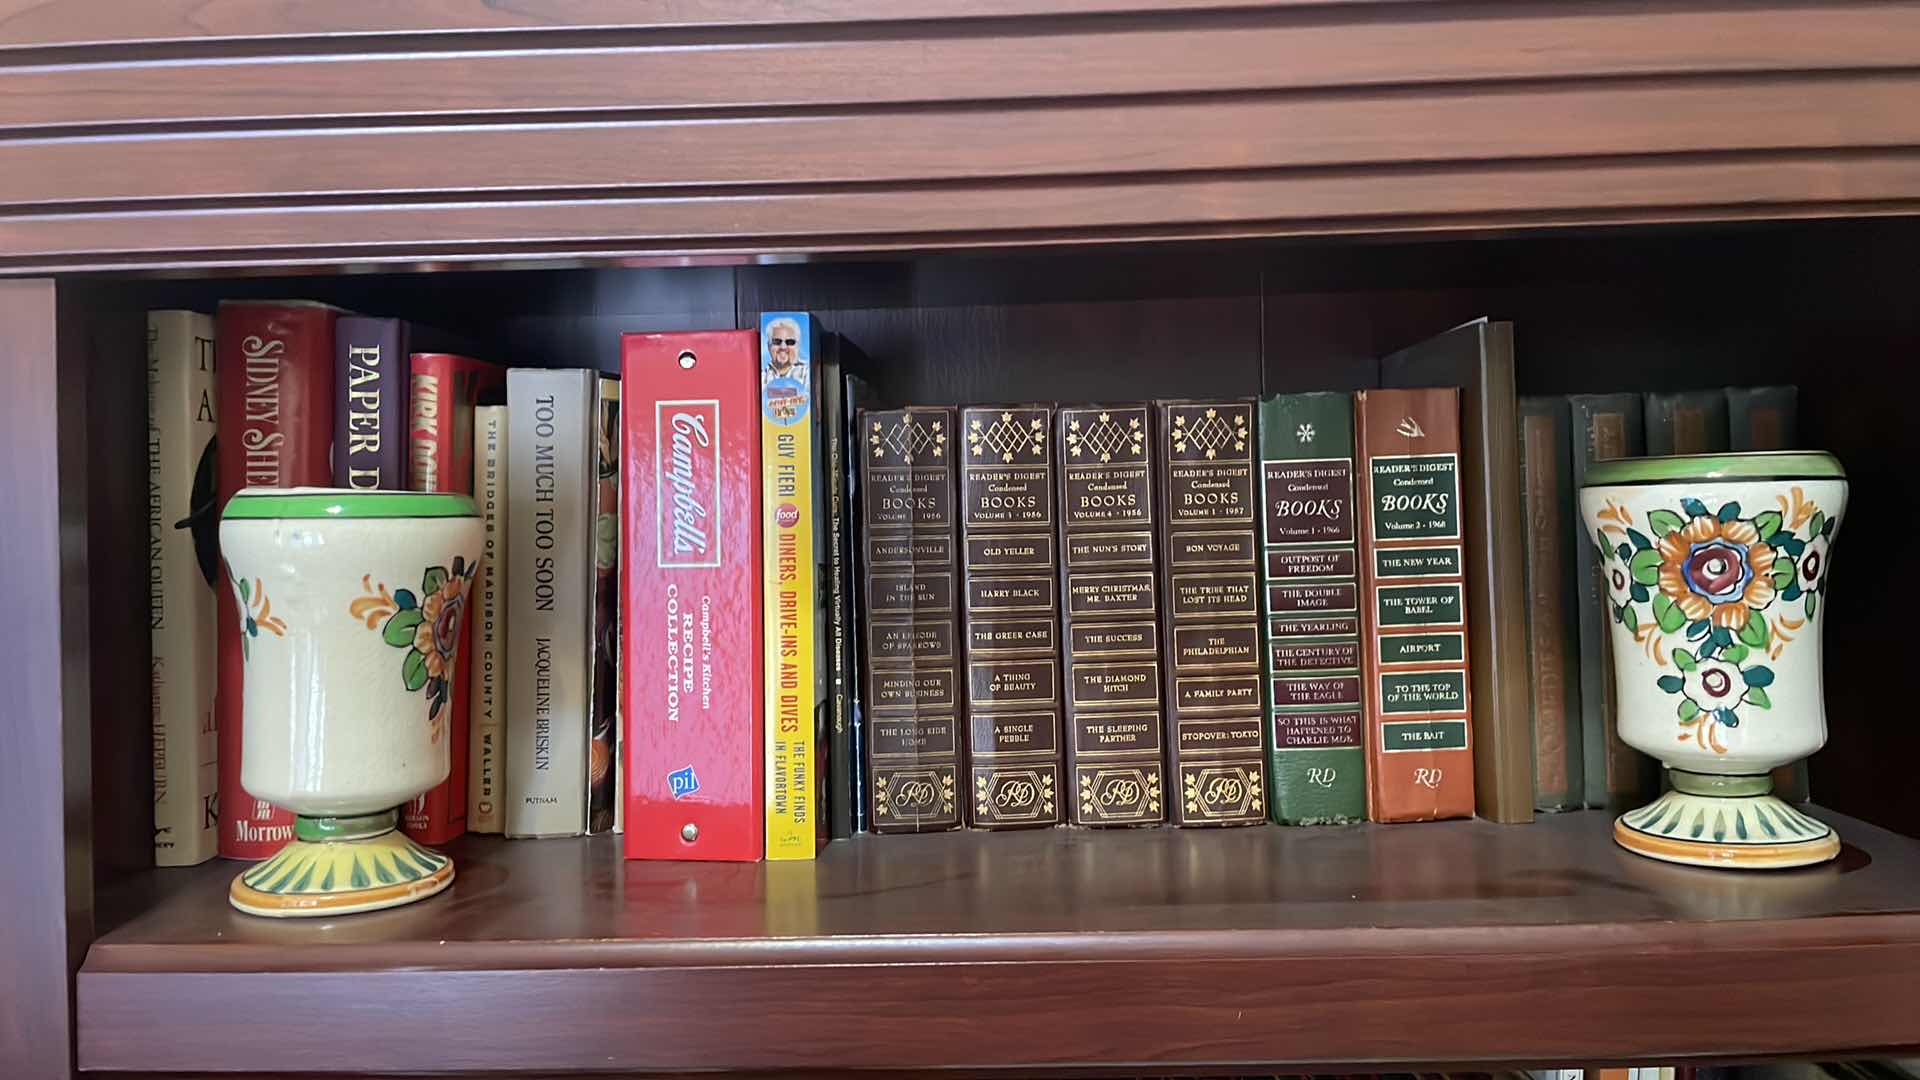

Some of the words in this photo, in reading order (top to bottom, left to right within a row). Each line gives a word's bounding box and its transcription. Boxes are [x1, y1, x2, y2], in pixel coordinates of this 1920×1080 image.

[242, 335, 285, 424] SIDNEY
[348, 343, 381, 457] PAPER
[415, 374, 438, 436] KIRK
[535, 395, 554, 437] TOO
[487, 419, 496, 451] THE
[777, 434, 794, 458] GUY
[1217, 468, 1248, 477] DIGEST
[1420, 463, 1454, 472] DIGEST
[535, 444, 554, 502] MUCH
[1014, 472, 1046, 480] DIGEST
[1114, 470, 1145, 479] DIGEST
[1268, 470, 1312, 479] READER'S
[1314, 469, 1346, 478] DIGEST
[778, 464, 796, 497] FIERI
[1191, 479, 1230, 489] Condensed
[486, 458, 496, 532] BRIDGES
[1184, 492, 1239, 505] BOOKS
[882, 498, 936, 509] BOOKS
[981, 496, 1036, 508] BOOKS
[1081, 494, 1136, 508] BOOKS
[1382, 493, 1449, 515] BOOKS
[776, 508, 798, 522] food
[1178, 508, 1209, 516] VOLUME
[1275, 500, 1343, 520] BOOKS
[149, 479, 163, 558] AFRICAN
[535, 508, 554, 550] TOO
[1280, 526, 1309, 535] Volume
[1384, 522, 1415, 531] Volume
[1416, 521, 1421, 529] 2
[832, 532, 840, 556] Secret
[1121, 544, 1147, 552] STORY
[1186, 545, 1203, 553] BON
[1206, 544, 1240, 552] VOYAGE
[485, 540, 494, 560] OF
[984, 548, 1001, 556] OLD
[1004, 548, 1034, 556] YELLER
[776, 533, 797, 585] DINERS,
[833, 557, 840, 565] to
[1281, 556, 1325, 564] OUTPOST
[1328, 554, 1340, 563] OF
[1382, 559, 1402, 568] THE
[1402, 558, 1424, 567] NEW
[1426, 557, 1452, 566] YEAR
[1288, 564, 1334, 574] FREEDOM
[535, 556, 554, 611] SOON
[833, 566, 841, 594] Healing
[981, 590, 1009, 598] HARRY
[1013, 589, 1040, 597] BLACK
[1072, 586, 1099, 594] MERRY
[1180, 587, 1197, 595] THE
[1200, 586, 1224, 594] TRIBE
[1226, 585, 1249, 593] THAT
[1282, 590, 1302, 599] THE
[1304, 588, 1341, 598] DOUBLE
[1104, 594, 1137, 602] BAXTER
[1184, 596, 1205, 604] LOST
[1224, 594, 1247, 603] HEAD
[1297, 598, 1329, 607] IMAGE
[1383, 598, 1403, 607] THE
[1404, 597, 1438, 606] TOWER
[1440, 596, 1454, 605] OF
[484, 567, 494, 642] MADISON
[833, 595, 841, 625] Virtually
[1404, 606, 1433, 615] BABEL
[700, 595, 711, 661] Campbell's
[780, 591, 798, 657] DRIVE-INS
[1280, 624, 1299, 633] THE
[1301, 623, 1349, 632] YEARLING
[975, 632, 993, 640] THE
[995, 632, 1023, 640] GREER
[1026, 630, 1048, 639] CASE
[1106, 634, 1143, 643] SUCCESS
[1208, 638, 1225, 646] THE
[667, 583, 679, 722] COLLECTION
[682, 612, 694, 693] RECIPE
[1184, 647, 1250, 656] PHILADELPHIAN
[1276, 649, 1294, 657] THE
[1294, 648, 1340, 657] CENTURY
[1399, 644, 1441, 654] AIRPORT
[1278, 658, 1297, 666] THE
[1300, 657, 1354, 666] DETECTIVE
[535, 637, 551, 715] JACQUELINE
[780, 663, 798, 688] AND
[994, 674, 1001, 682] A
[1003, 674, 1030, 682] THING
[1084, 676, 1102, 684] THE
[1106, 674, 1146, 683] DIAMOND
[483, 651, 493, 718] COUNTY
[702, 664, 712, 709] Kitchen
[990, 684, 1002, 692] OF
[1004, 682, 1037, 691] BEAUTY
[1104, 684, 1128, 693] HITCH
[1286, 683, 1306, 691] THE
[1309, 682, 1330, 691] WAY
[1395, 685, 1409, 693] TO
[1410, 684, 1431, 692] THE
[1432, 683, 1451, 692] TOP
[1194, 690, 1225, 698] FAMILY
[1227, 688, 1253, 697] PARTY
[1290, 692, 1311, 700] THE
[1388, 694, 1400, 702] OF
[1402, 693, 1422, 702] THE
[1424, 692, 1459, 701] WORLD
[780, 695, 798, 733] DIVES
[1278, 718, 1290, 726] SO
[1294, 718, 1316, 726] THIS
[1320, 717, 1329, 725] IS
[1330, 716, 1358, 725] WHAT
[880, 728, 897, 736] THE
[994, 726, 1001, 734] A
[1004, 725, 1033, 733] SINGLE
[1086, 726, 1104, 734] THE
[1107, 724, 1148, 733] SLEEPING
[1286, 726, 1335, 736] HAPPENED
[1337, 726, 1352, 734] TO
[1000, 734, 1029, 743] PEBBLE
[1100, 734, 1136, 743] PARTNER
[1231, 730, 1259, 739] TOKYO
[1402, 732, 1422, 741] THE
[1424, 731, 1445, 740] BAIT
[535, 718, 550, 771] BRISKIN
[1286, 736, 1329, 745] CHARLIE
[775, 742, 787, 751] IN
[793, 741, 805, 758] THE
[482, 733, 492, 797] WALLER
[793, 761, 805, 792] FUNKY
[1307, 768, 1336, 788] RD
[1414, 768, 1442, 788] RD
[775, 755, 787, 815] FLAVORTOWN
[793, 795, 806, 823] FINDS
[235, 820, 294, 842] Morrow
